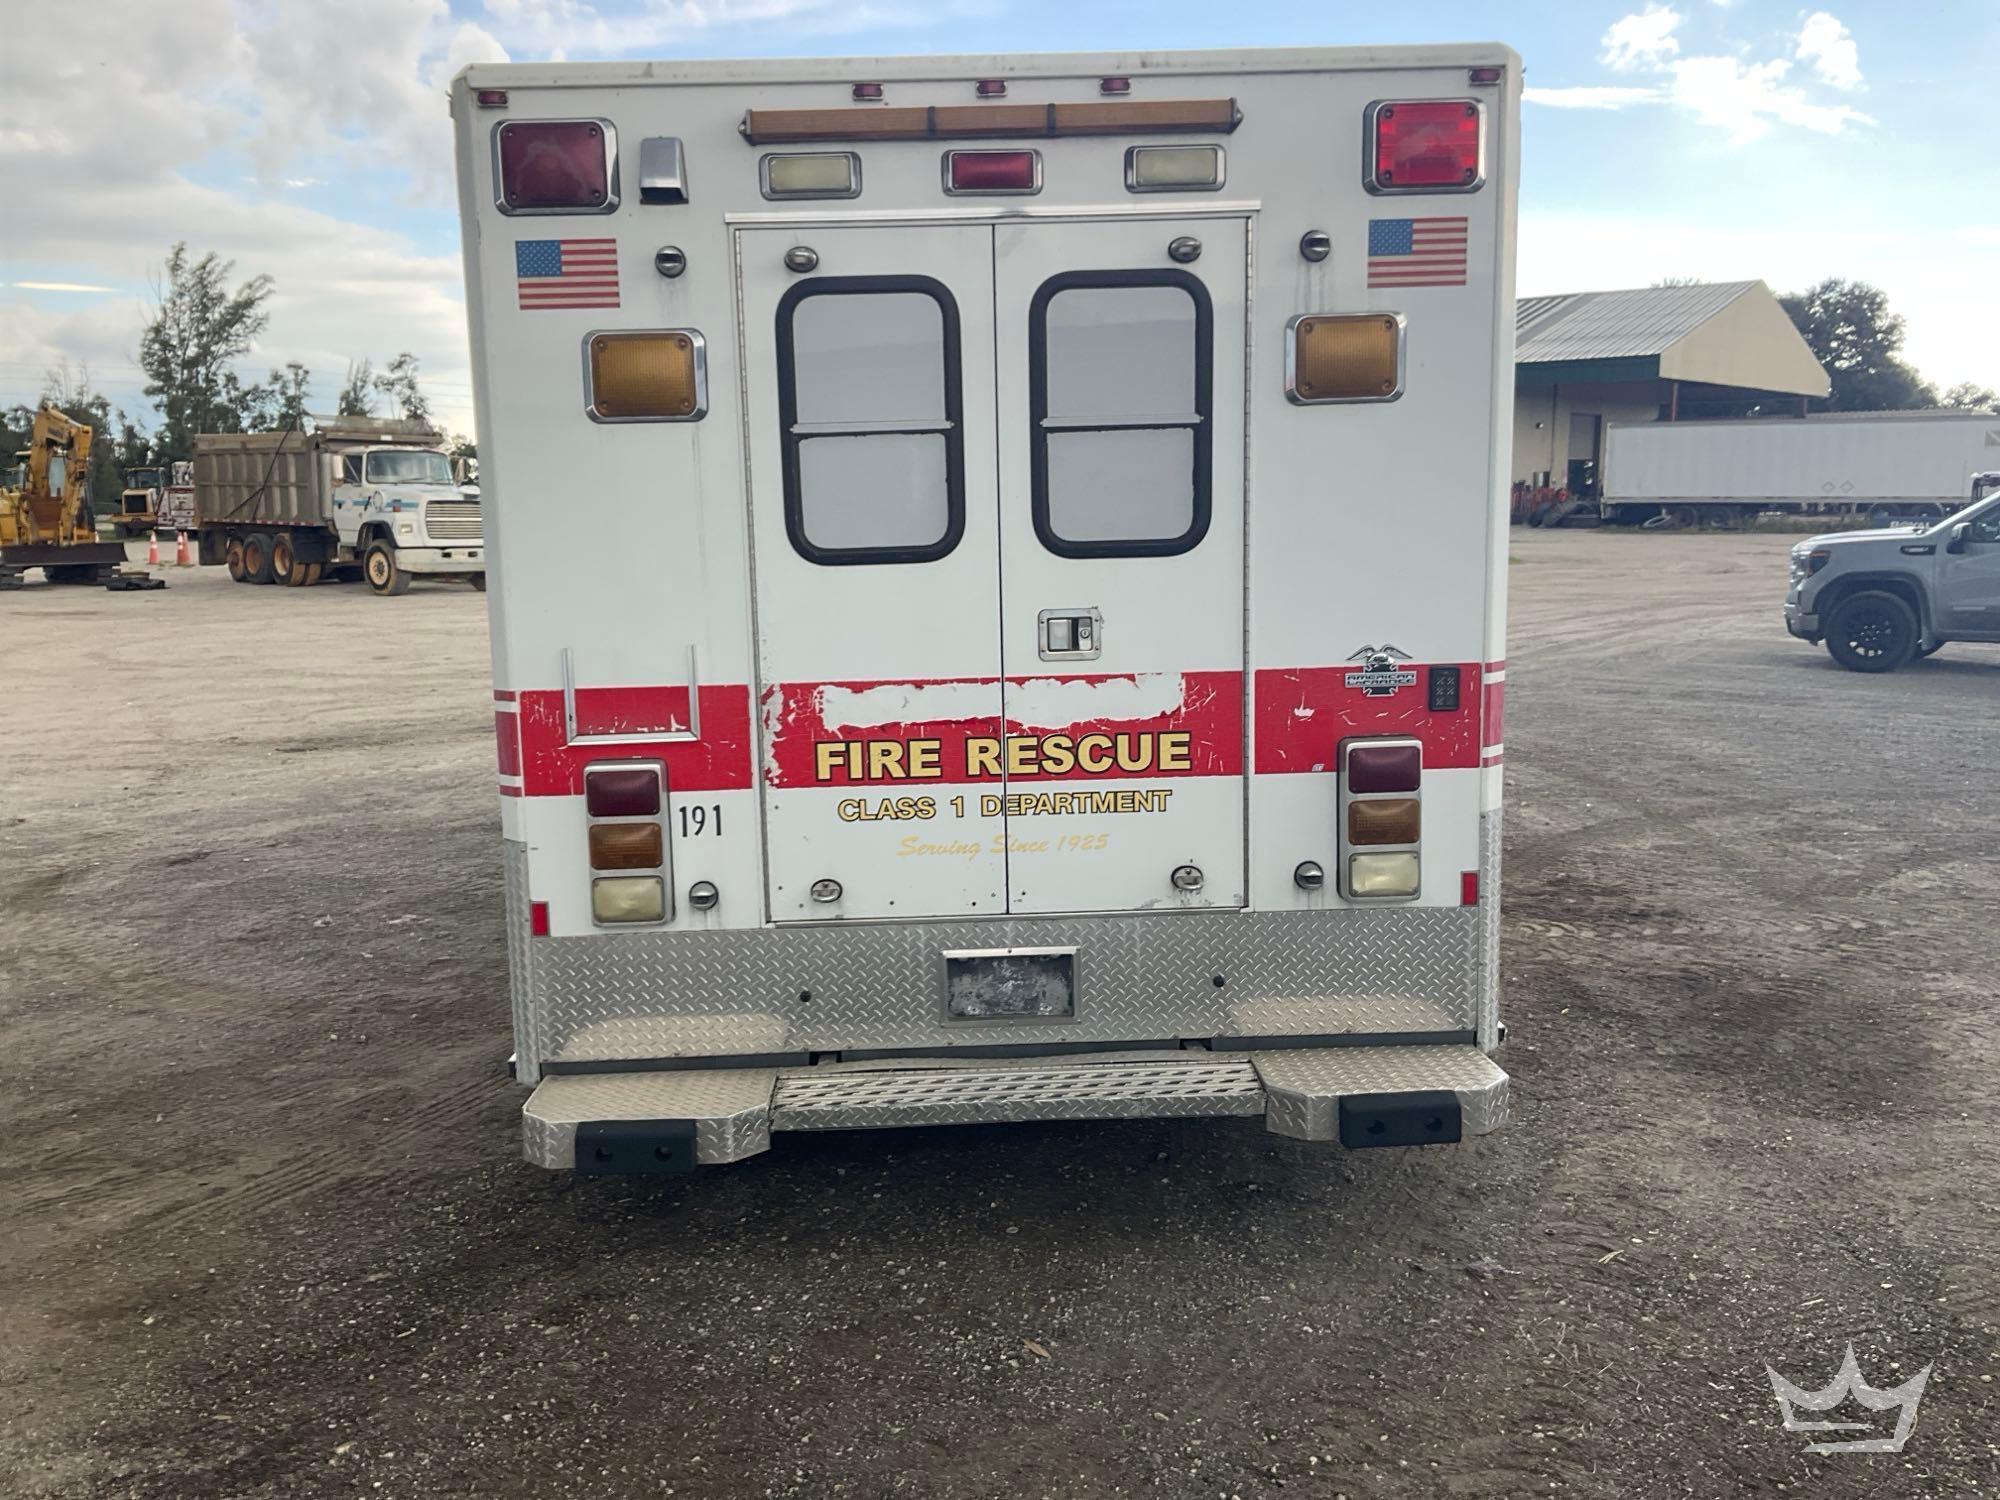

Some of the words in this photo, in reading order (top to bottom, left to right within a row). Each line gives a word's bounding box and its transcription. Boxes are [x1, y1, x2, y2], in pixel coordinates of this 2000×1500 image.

[815, 738, 942, 781] FIRE
[965, 730, 1192, 778] RESCUE
[679, 804, 722, 837] 191
[837, 796, 936, 822] CLASS
[950, 795, 965, 818] 1
[980, 789, 1173, 817] DEPARTMENT
[896, 834, 984, 860] Serving
[989, 833, 1051, 855] Since
[1056, 833, 1110, 851] 1925
